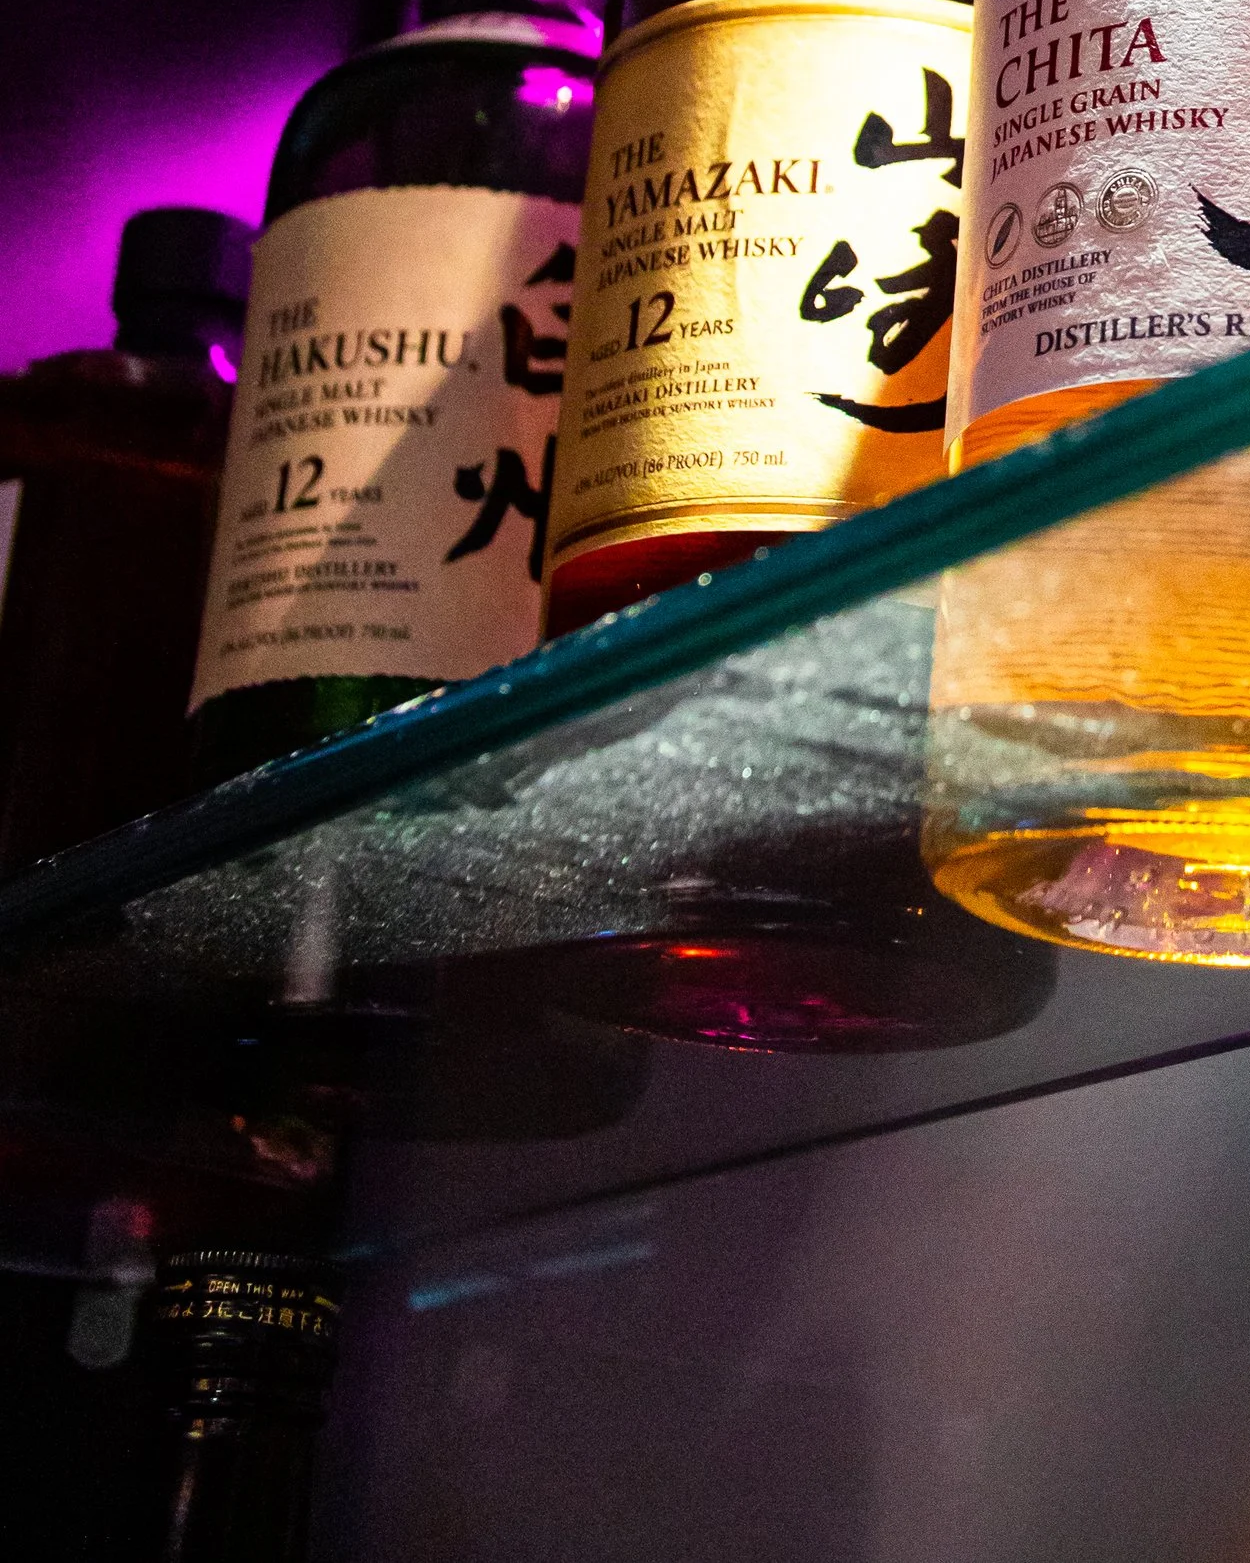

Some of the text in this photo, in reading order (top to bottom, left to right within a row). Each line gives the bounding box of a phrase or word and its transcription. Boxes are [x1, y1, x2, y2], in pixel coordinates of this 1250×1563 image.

[996, 18, 1167, 108] CHITA
[994, 79, 1161, 148] SINGLE GRAIN
[612, 131, 665, 179] THE
[991, 108, 1229, 185] JAPANESE WHISKY
[607, 158, 822, 228] YAMAZAKI
[602, 209, 743, 259] SINGLE MALT
[598, 236, 804, 292] JAPANESE WHISKY
[983, 249, 1112, 302] CHITA DISTILLERY
[269, 297, 318, 336] THE
[981, 291, 1077, 335] SUNTORY WHISKY
[982, 271, 1097, 319] FROM THE HOUSE OF
[625, 290, 676, 352] 12
[680, 318, 734, 339] YEARS
[259, 326, 465, 386] HAKUSHU
[679, 362, 690, 374] in
[695, 360, 730, 375] Japan
[320, 377, 386, 401] MALT
[655, 377, 760, 400] DISTILLERY
[669, 398, 723, 414] SUNTORY
[727, 396, 776, 409] WHISKY
[342, 405, 438, 428] WHISKY
[273, 453, 326, 515] 12
[667, 449, 723, 472] PROOF)
[732, 451, 759, 467] 750
[208, 1280, 240, 1294] OPEN
[246, 1282, 273, 1298] THIS
